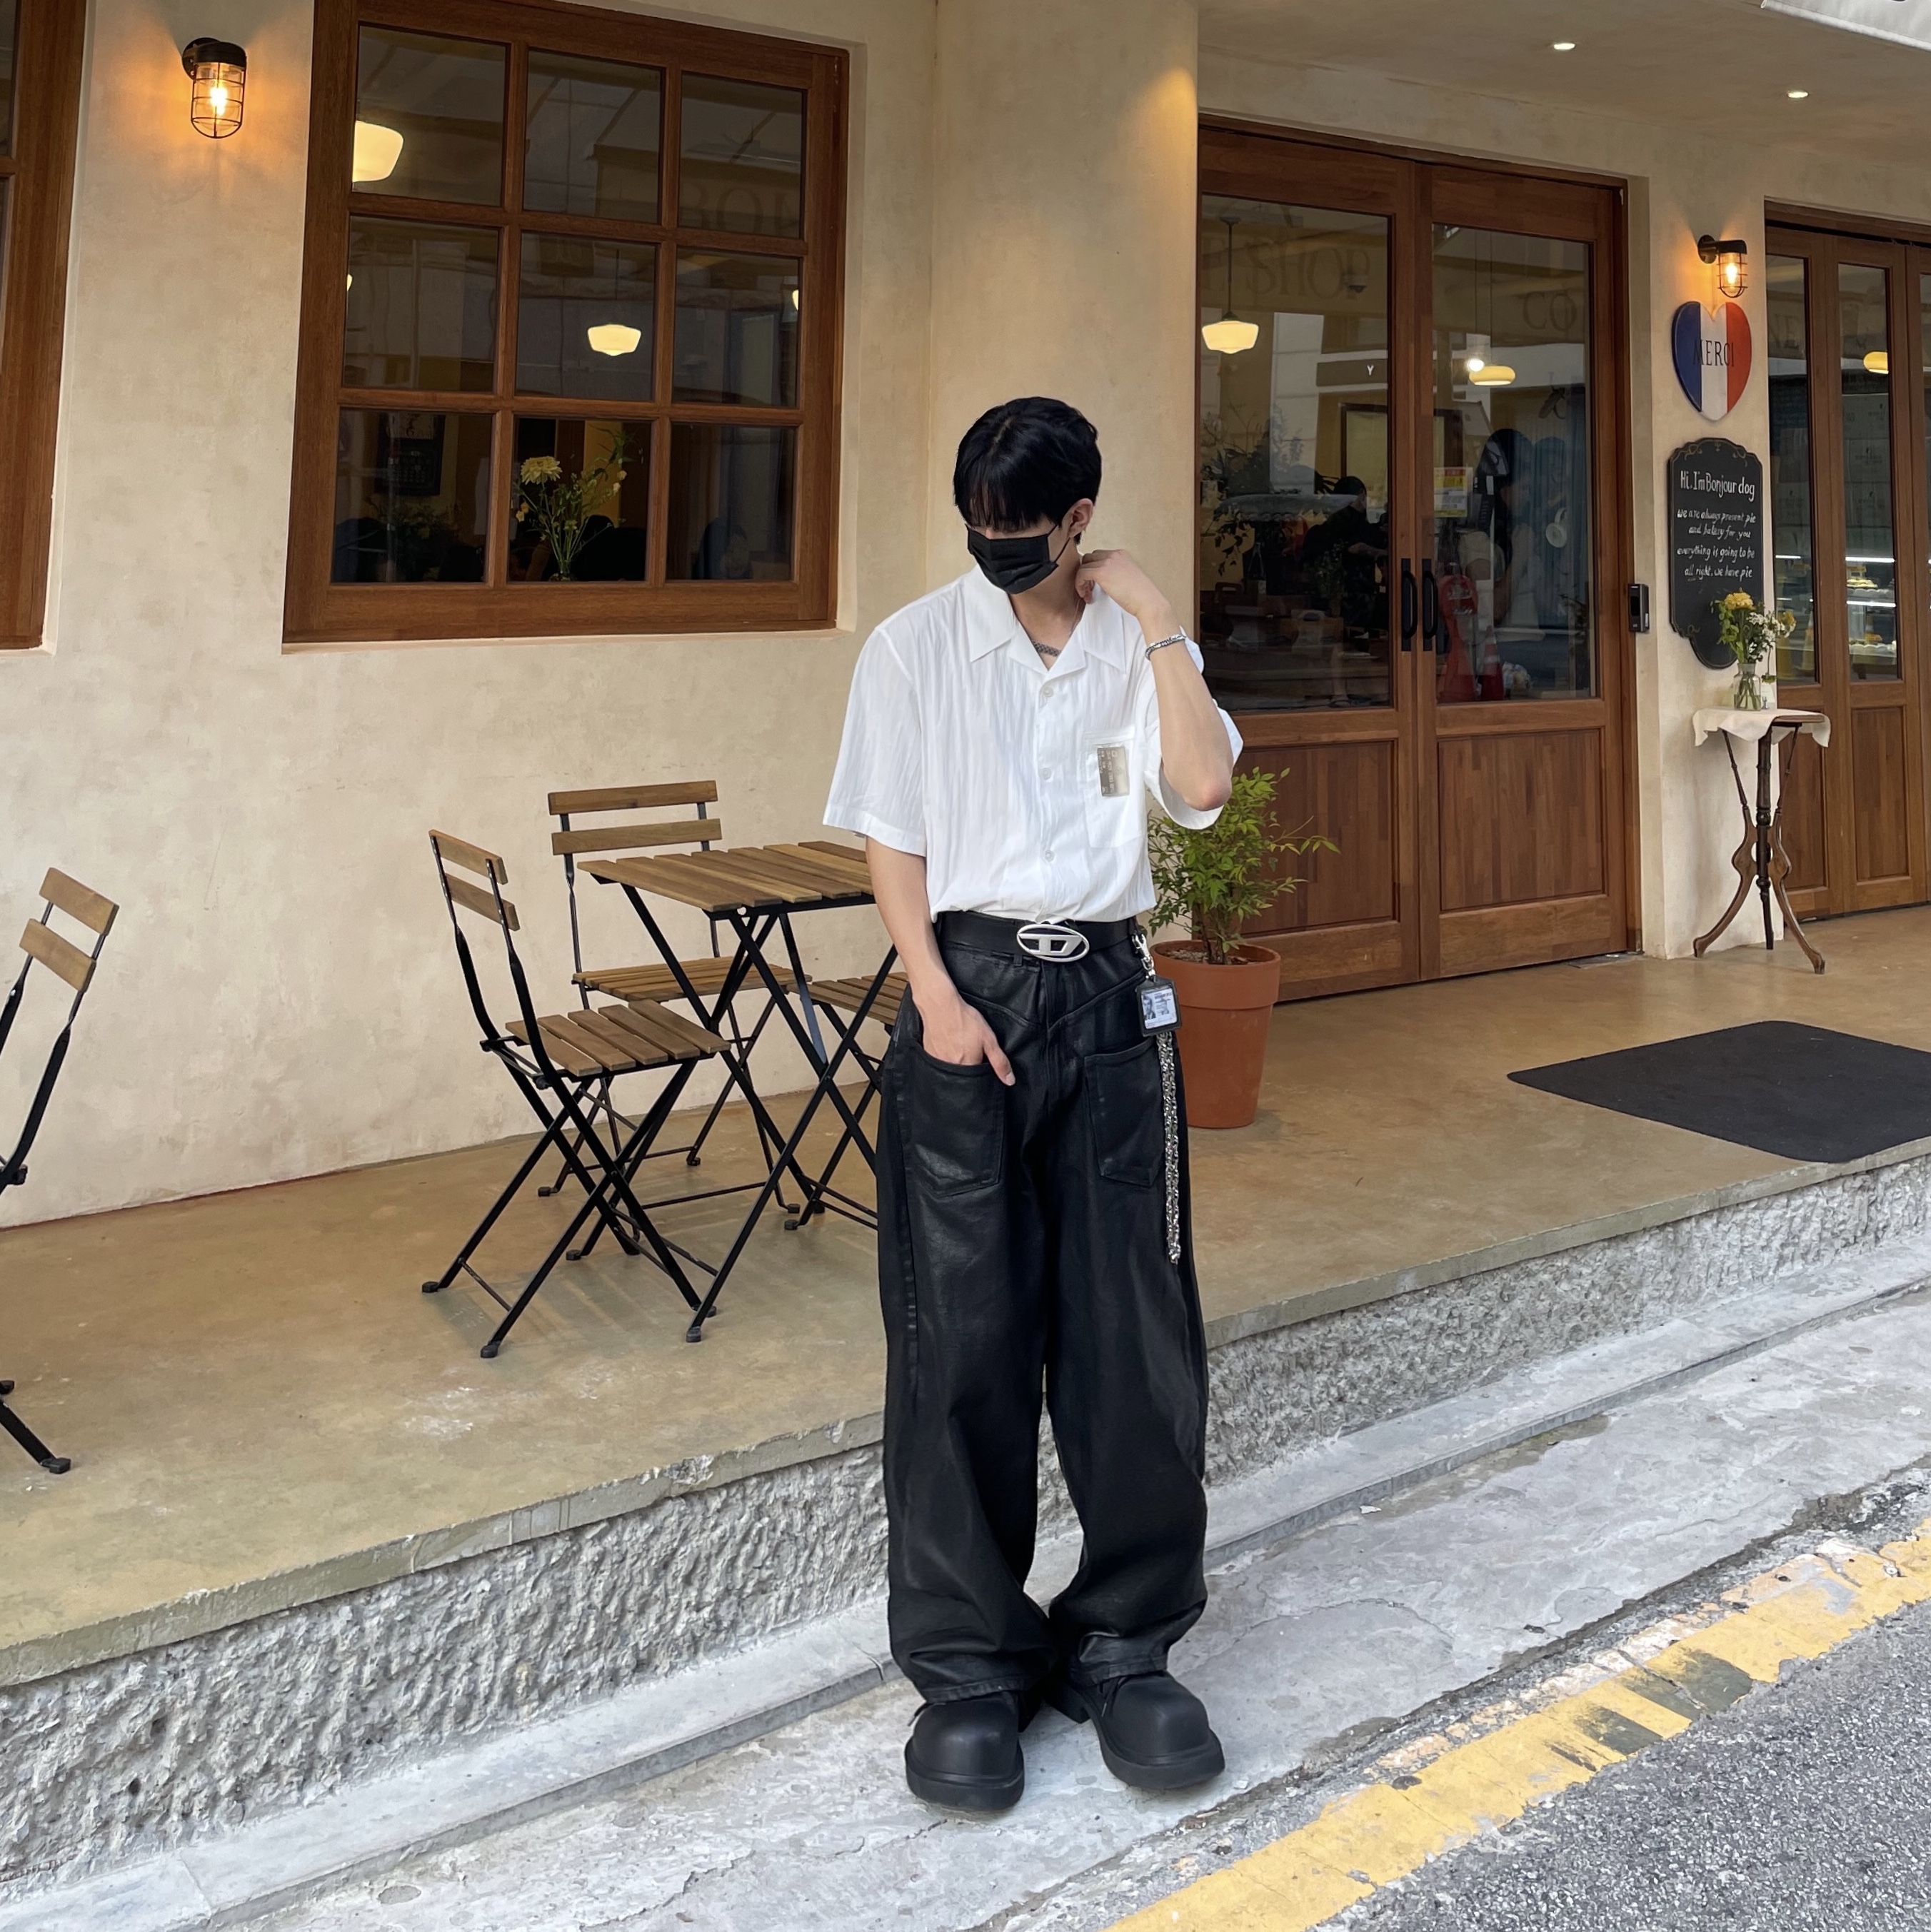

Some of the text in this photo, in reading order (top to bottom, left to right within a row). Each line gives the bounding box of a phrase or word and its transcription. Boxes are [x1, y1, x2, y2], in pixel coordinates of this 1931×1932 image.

[1693, 339, 1735, 367] MERCI
[1738, 476, 1755, 501] dog
[1688, 510, 1700, 519] are
[1744, 512, 1757, 528] pie
[1688, 523, 1702, 534] and
[1724, 525, 1736, 540] for
[1736, 530, 1752, 541] you
[1677, 544, 1755, 563] everything is going to be
[1684, 563, 1695, 576] all
[1714, 567, 1723, 576] we
[1725, 564, 1739, 577] have
[1740, 565, 1753, 583] pie
